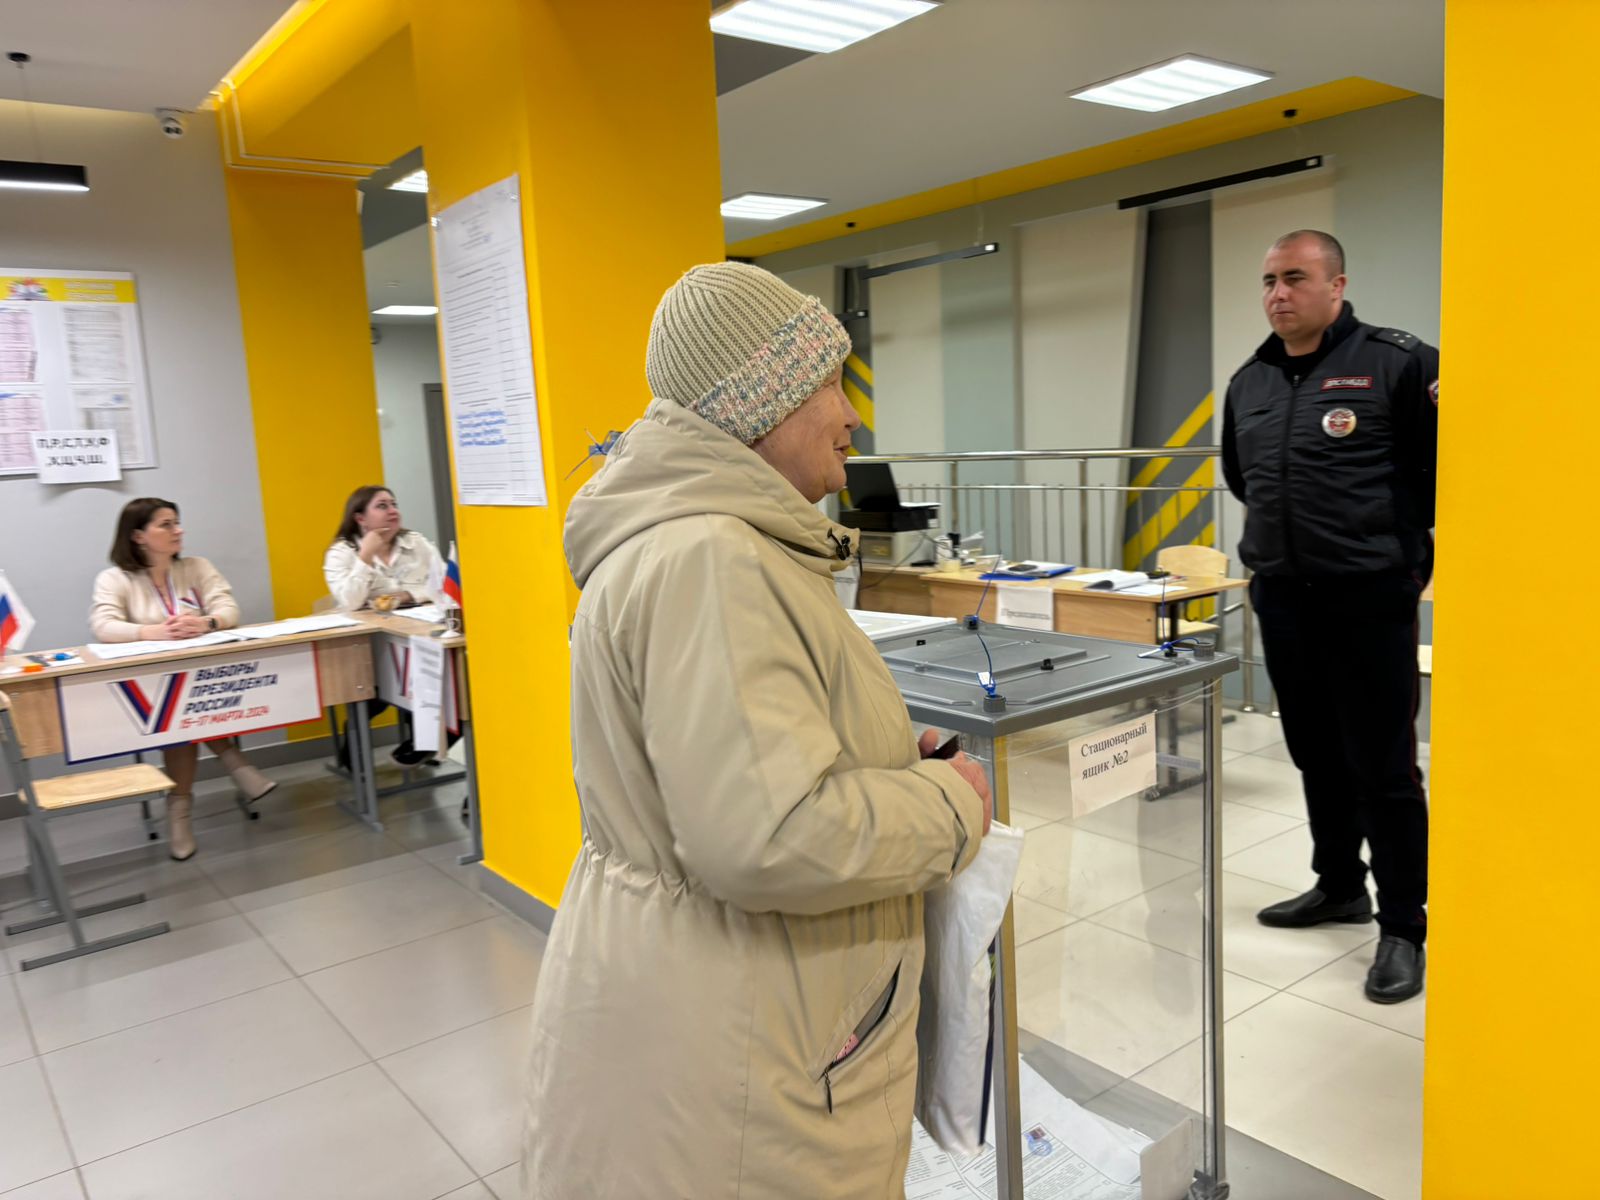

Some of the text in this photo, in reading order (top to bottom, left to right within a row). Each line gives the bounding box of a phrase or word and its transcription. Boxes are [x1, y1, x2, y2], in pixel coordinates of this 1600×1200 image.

[195, 661, 259, 681] ВЫБОРЫ
[189, 674, 278, 697] ПРЕЗИДЕНТА
[184, 695, 243, 714] РОССИИ
[209, 710, 244, 722] МАРТА
[246, 706, 270, 718] 2024
[1081, 722, 1147, 758] Стационарный
[1082, 749, 1129, 781] ящик №2
